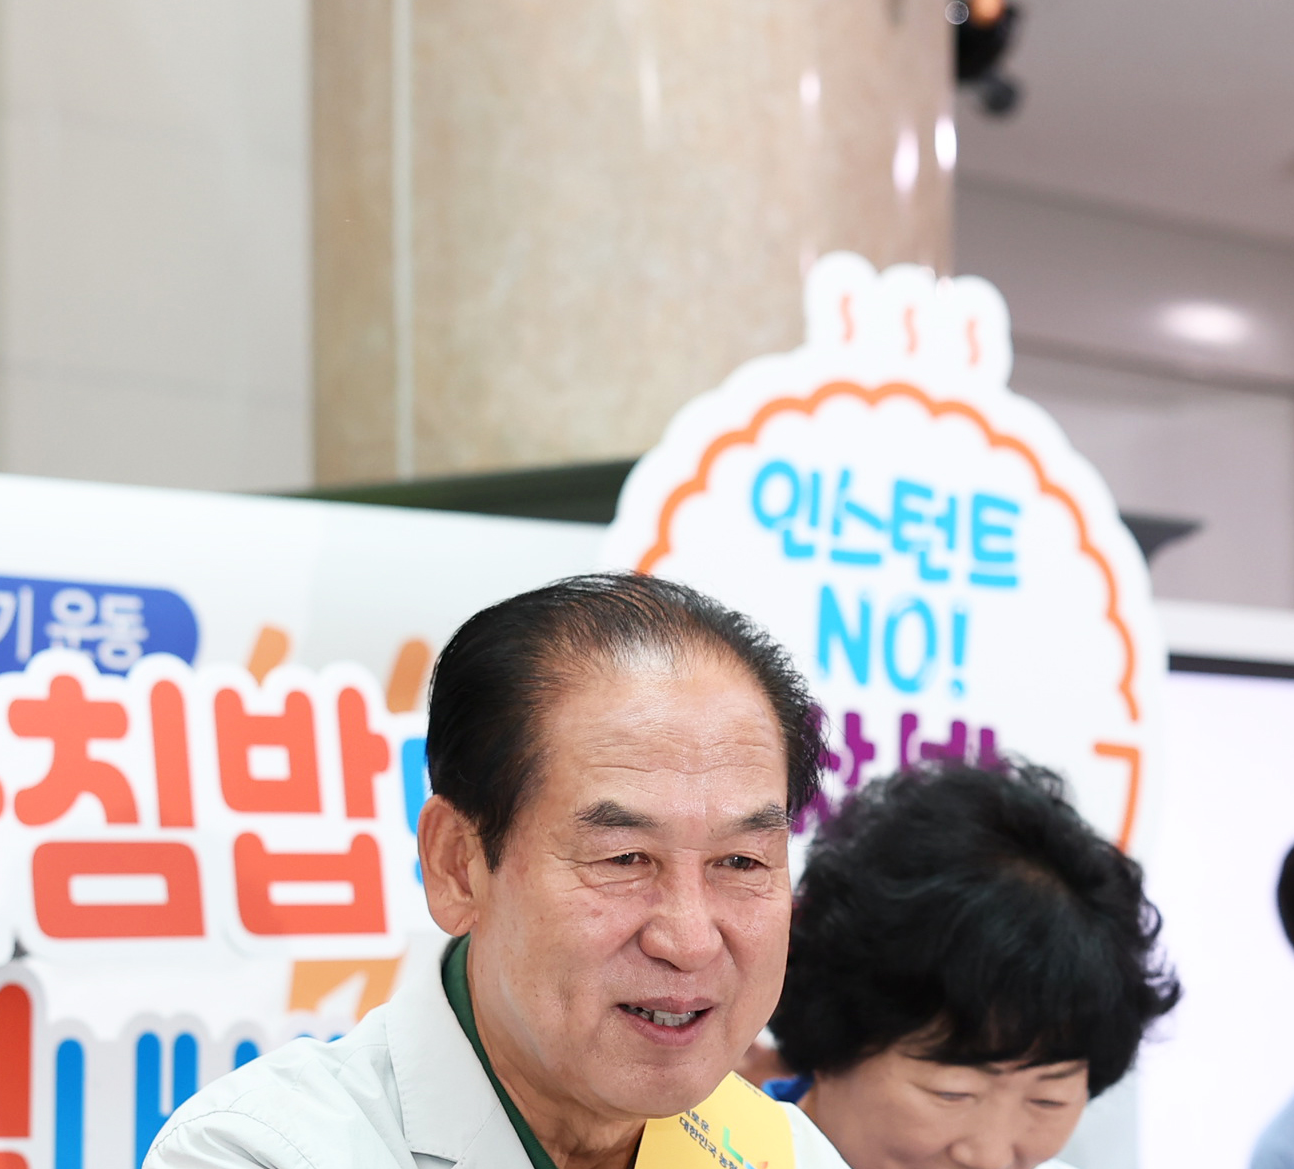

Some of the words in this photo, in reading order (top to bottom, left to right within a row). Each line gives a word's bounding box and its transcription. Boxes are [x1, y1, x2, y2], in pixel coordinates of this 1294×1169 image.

[752, 460, 1021, 588] 인스턴트
[45, 587, 149, 669] 운동
[815, 583, 967, 699] NO!
